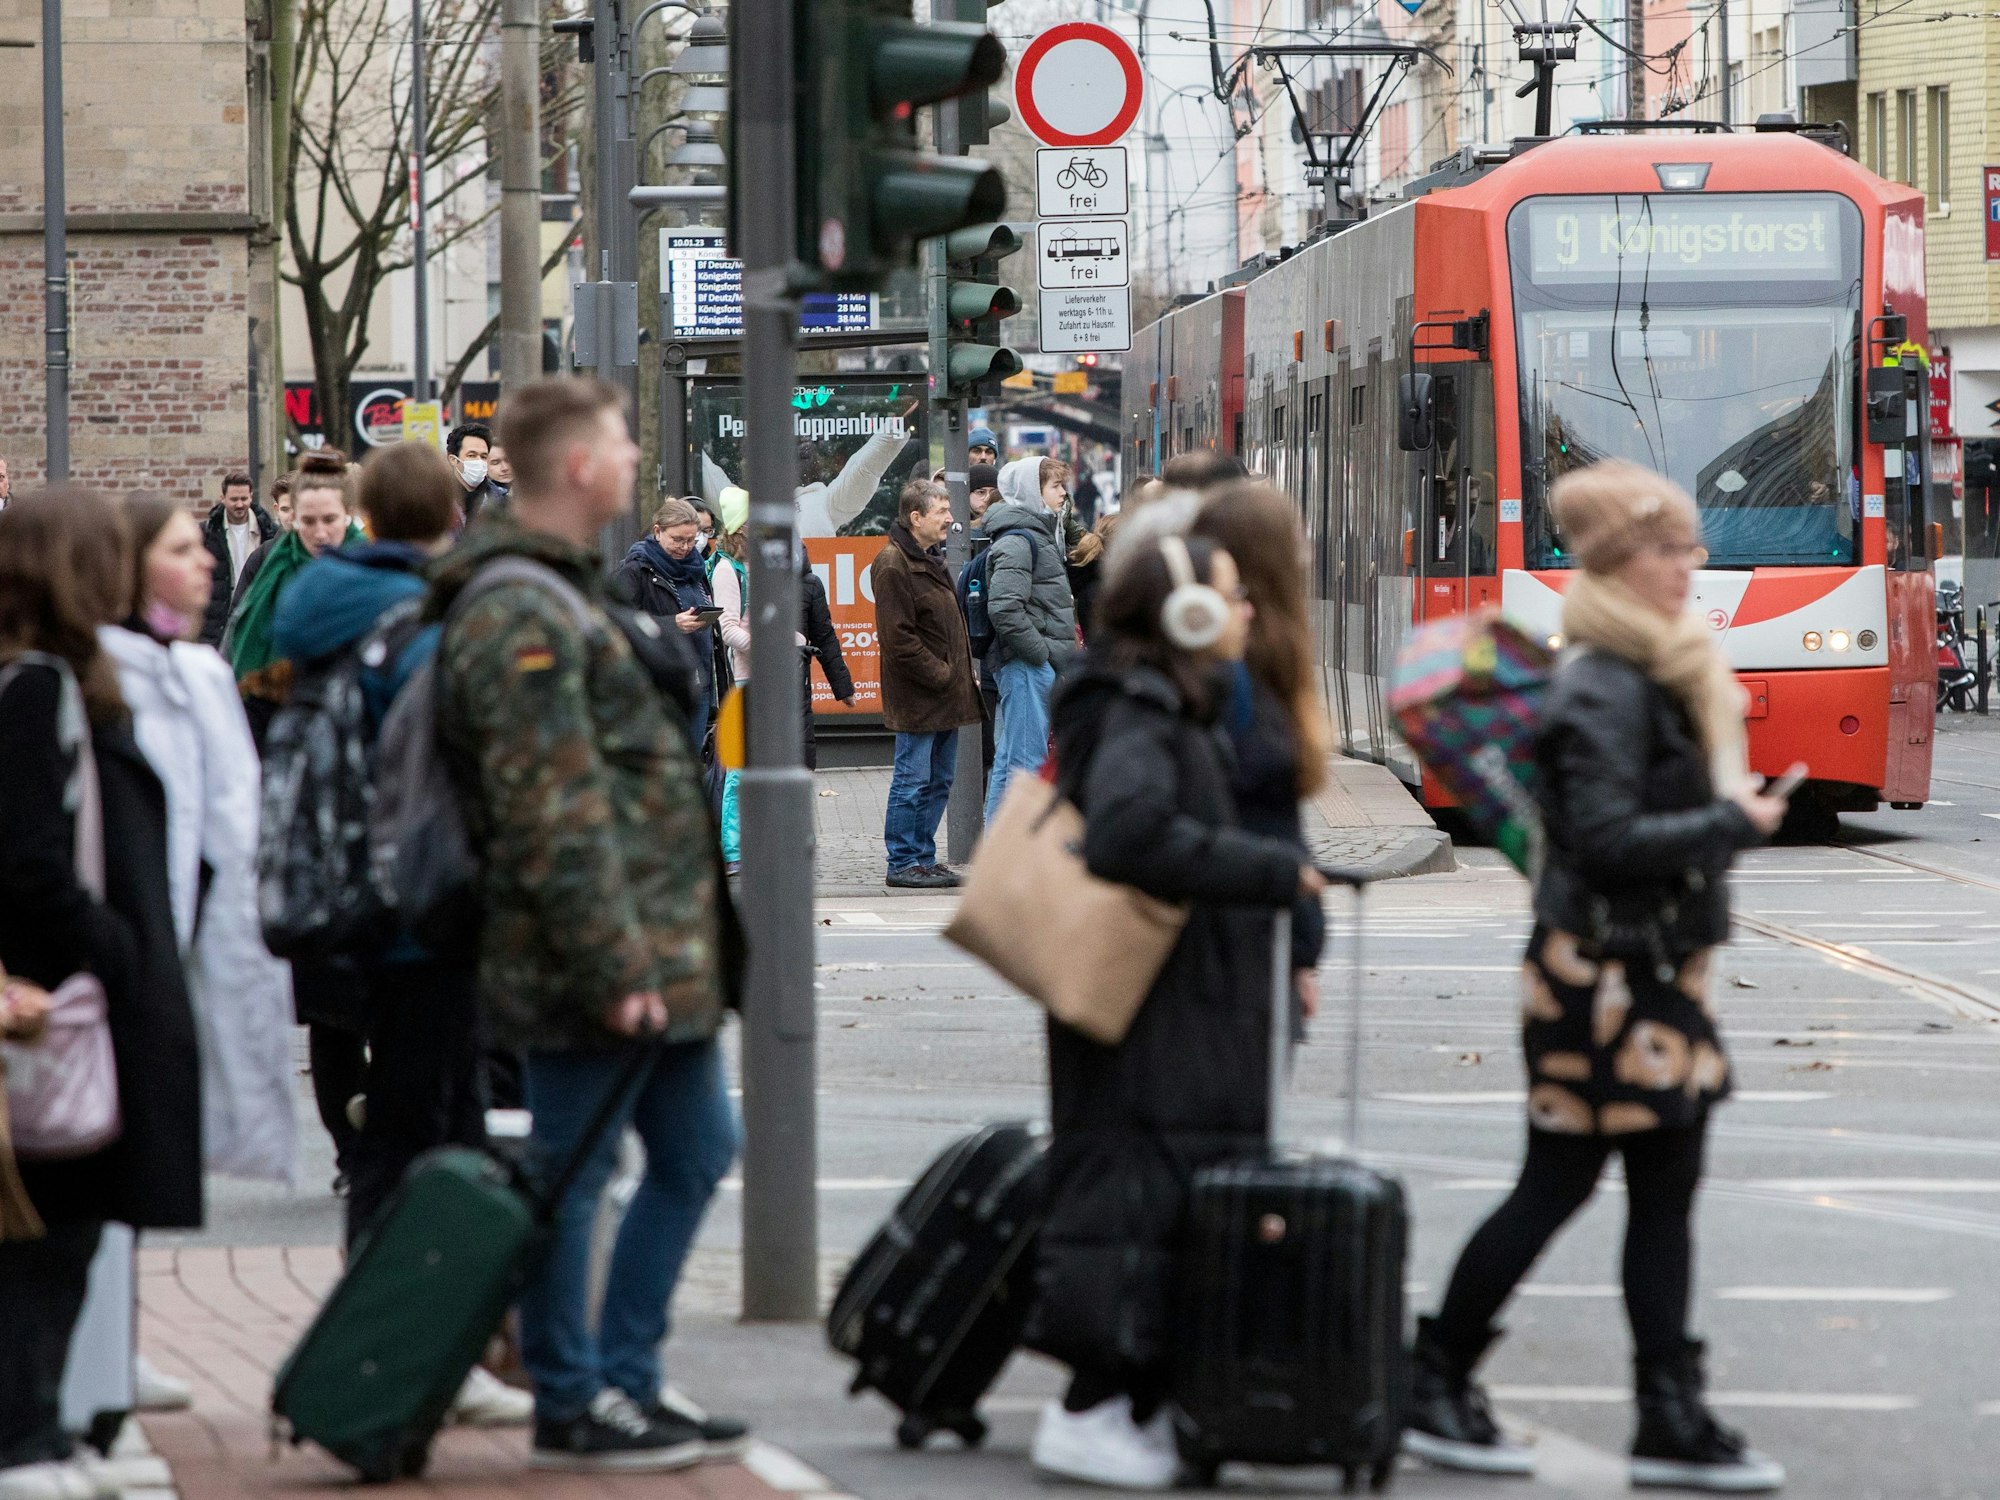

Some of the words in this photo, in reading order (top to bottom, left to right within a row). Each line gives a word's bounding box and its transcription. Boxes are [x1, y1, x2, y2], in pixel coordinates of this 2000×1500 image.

[1069, 193, 1097, 208] frei
[673, 238, 705, 247] 10.01.23
[1555, 214, 1579, 264] 9
[1600, 212, 1825, 263] Königsforst
[681, 261, 687, 269] 9
[697, 260, 707, 269] Bf
[681, 272, 687, 280] 9
[698, 271, 742, 282] Königsforst
[1070, 264, 1098, 279] frei
[681, 283, 687, 291] 9
[698, 282, 742, 292] Königsforst
[682, 294, 688, 302] 9
[698, 293, 707, 302] Bf
[837, 293, 848, 301] 24
[849, 293, 866, 301] Min
[1065, 294, 1106, 304] Lieferverkehr
[682, 305, 688, 313] 9
[698, 304, 743, 315] Königsforst
[837, 303, 849, 313] 28
[849, 303, 867, 312] Min
[837, 314, 849, 323] 38
[849, 314, 867, 323] Min
[1058, 308, 1087, 319] werktags
[1108, 308, 1114, 316] u.
[682, 316, 688, 324] 9
[698, 315, 743, 325] Königsforst
[1059, 320, 1081, 330] Zufahrt
[1083, 321, 1091, 330] zu
[1092, 320, 1116, 329] Hausnr.
[683, 327, 695, 335] 20
[695, 326, 730, 335] Minuten
[1073, 333, 1078, 342] 6
[1084, 333, 1088, 341] 8
[1090, 332, 1100, 341] frei
[793, 411, 904, 441] loppenburg
[854, 681, 880, 689] Onlin
